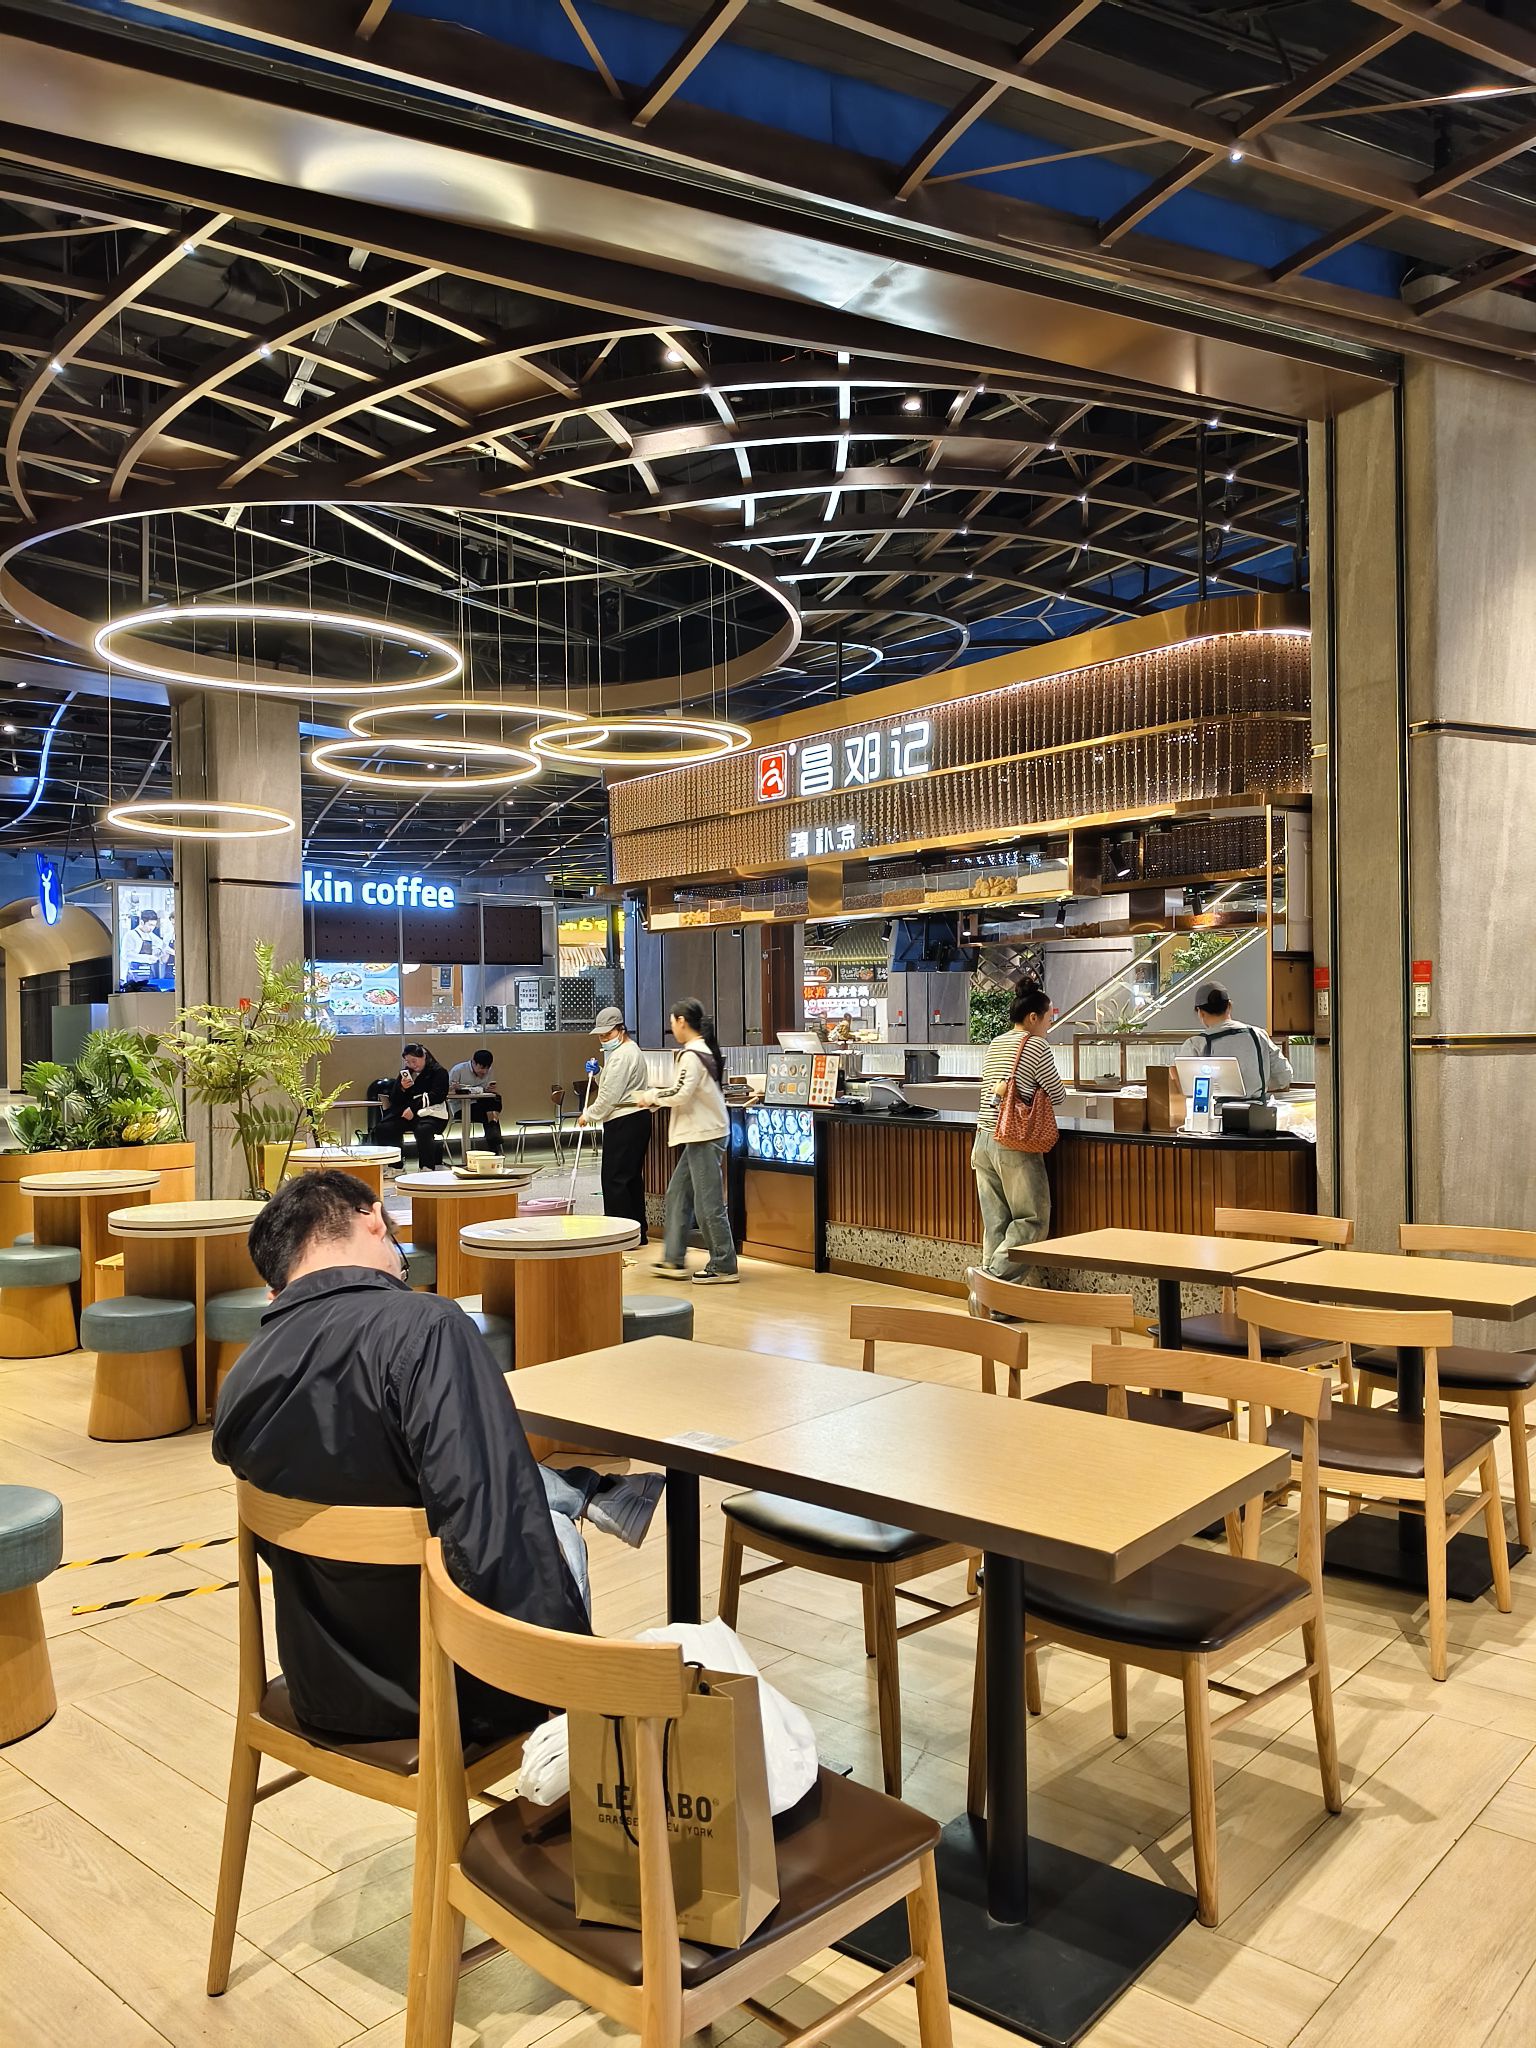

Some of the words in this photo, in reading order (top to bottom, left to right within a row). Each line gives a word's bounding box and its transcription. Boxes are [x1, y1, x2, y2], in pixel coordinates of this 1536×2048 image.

[801, 721, 930, 796] 昌邓记
[304, 870, 353, 903] kin
[361, 876, 455, 908] coffee
[597, 1783, 632, 1810] LE
[687, 1826, 714, 1838] YORK
